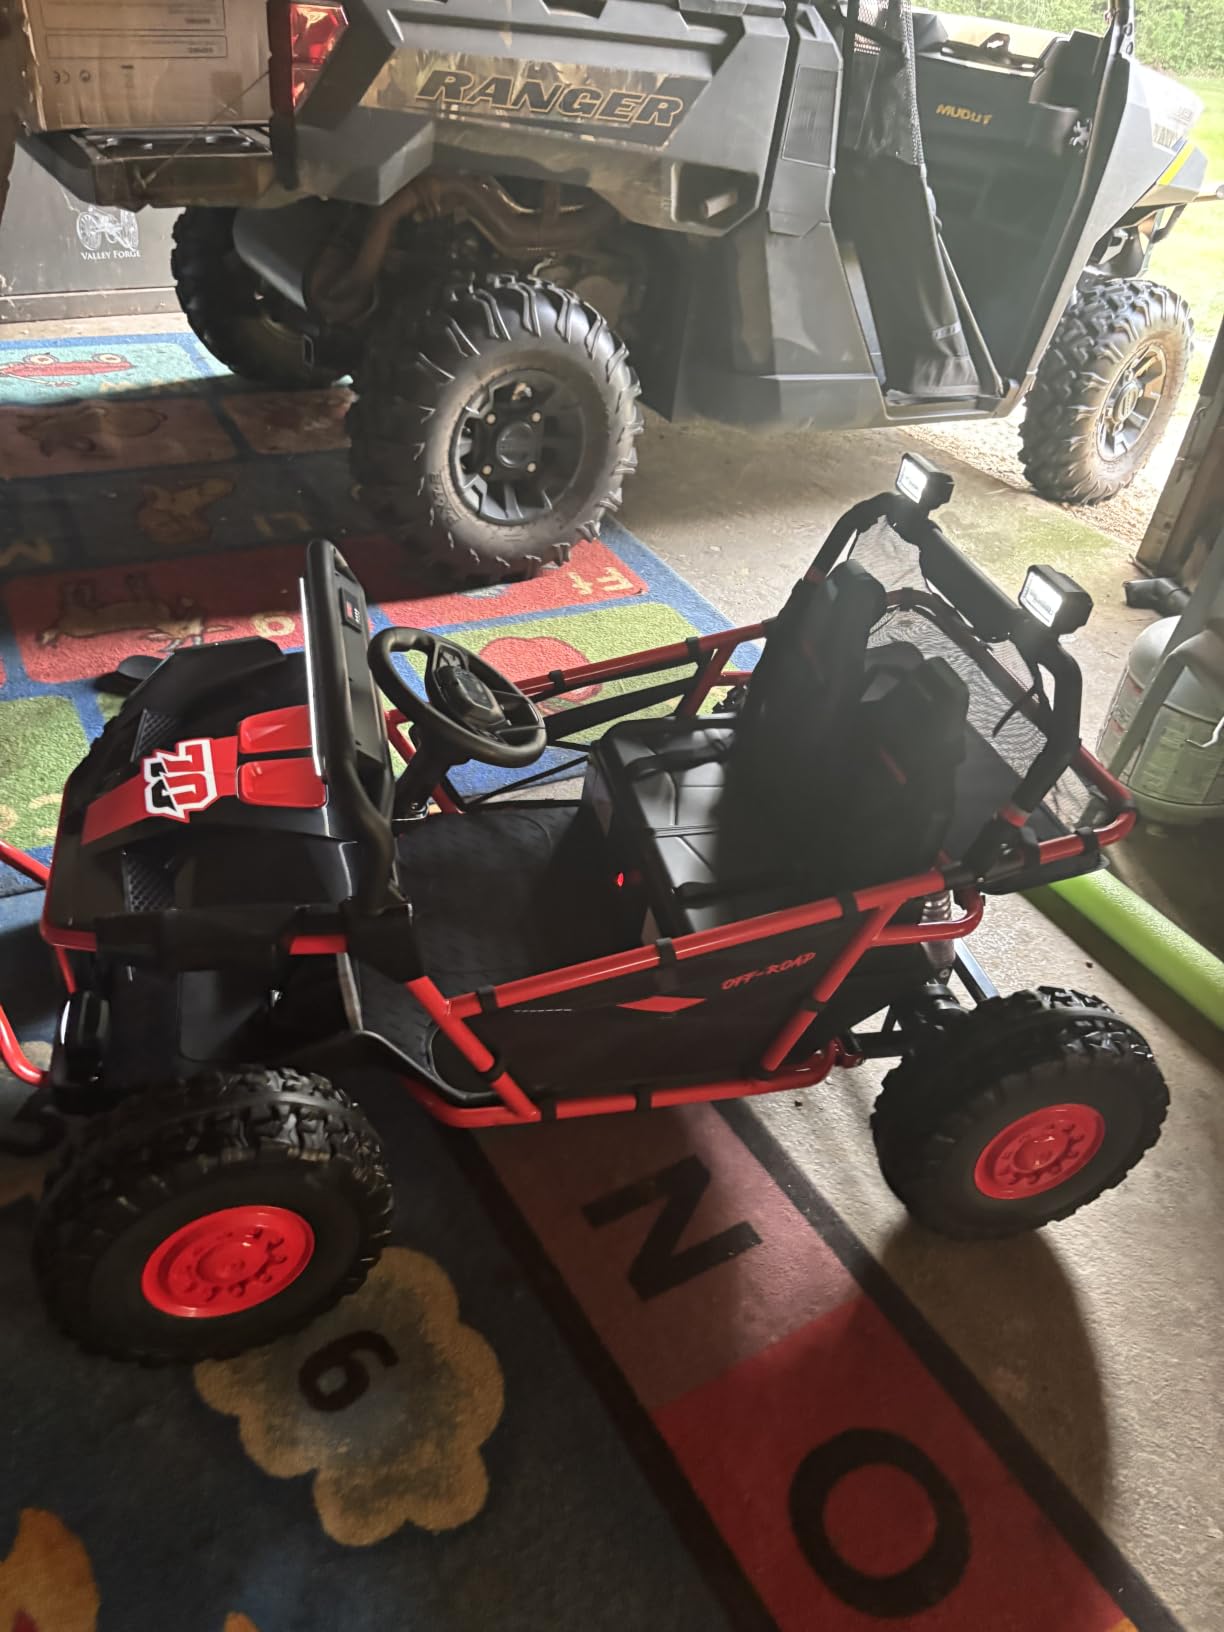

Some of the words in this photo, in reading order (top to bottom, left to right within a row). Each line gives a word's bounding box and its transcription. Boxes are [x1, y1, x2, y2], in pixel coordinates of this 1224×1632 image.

[416, 69, 684, 128] RANGER
[80, 251, 111, 261] VALLEY
[113, 249, 141, 259] FORGE
[720, 952, 817, 991] OFF-ROAD
